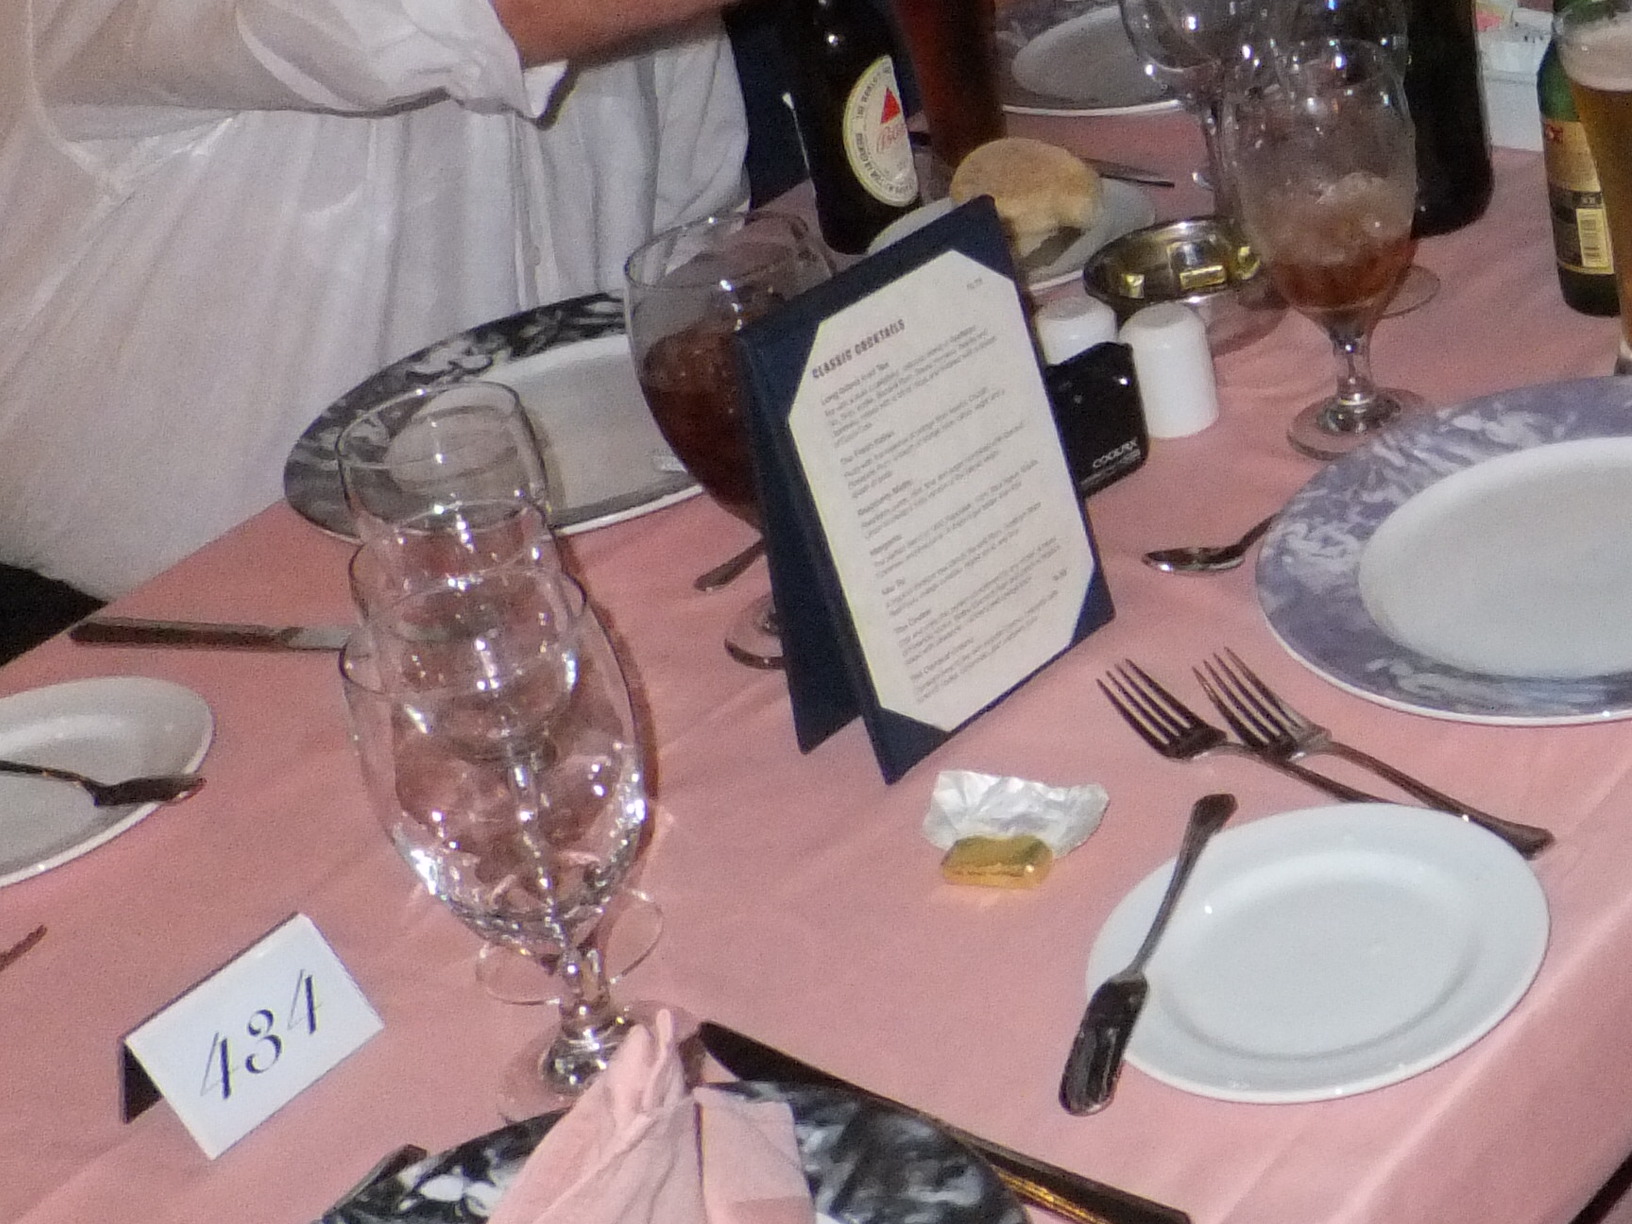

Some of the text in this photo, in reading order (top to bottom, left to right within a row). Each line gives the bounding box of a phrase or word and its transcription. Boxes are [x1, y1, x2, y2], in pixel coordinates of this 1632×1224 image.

[812, 319, 905, 379] CLASSIC COCKTAILS
[201, 968, 324, 1100] 434
